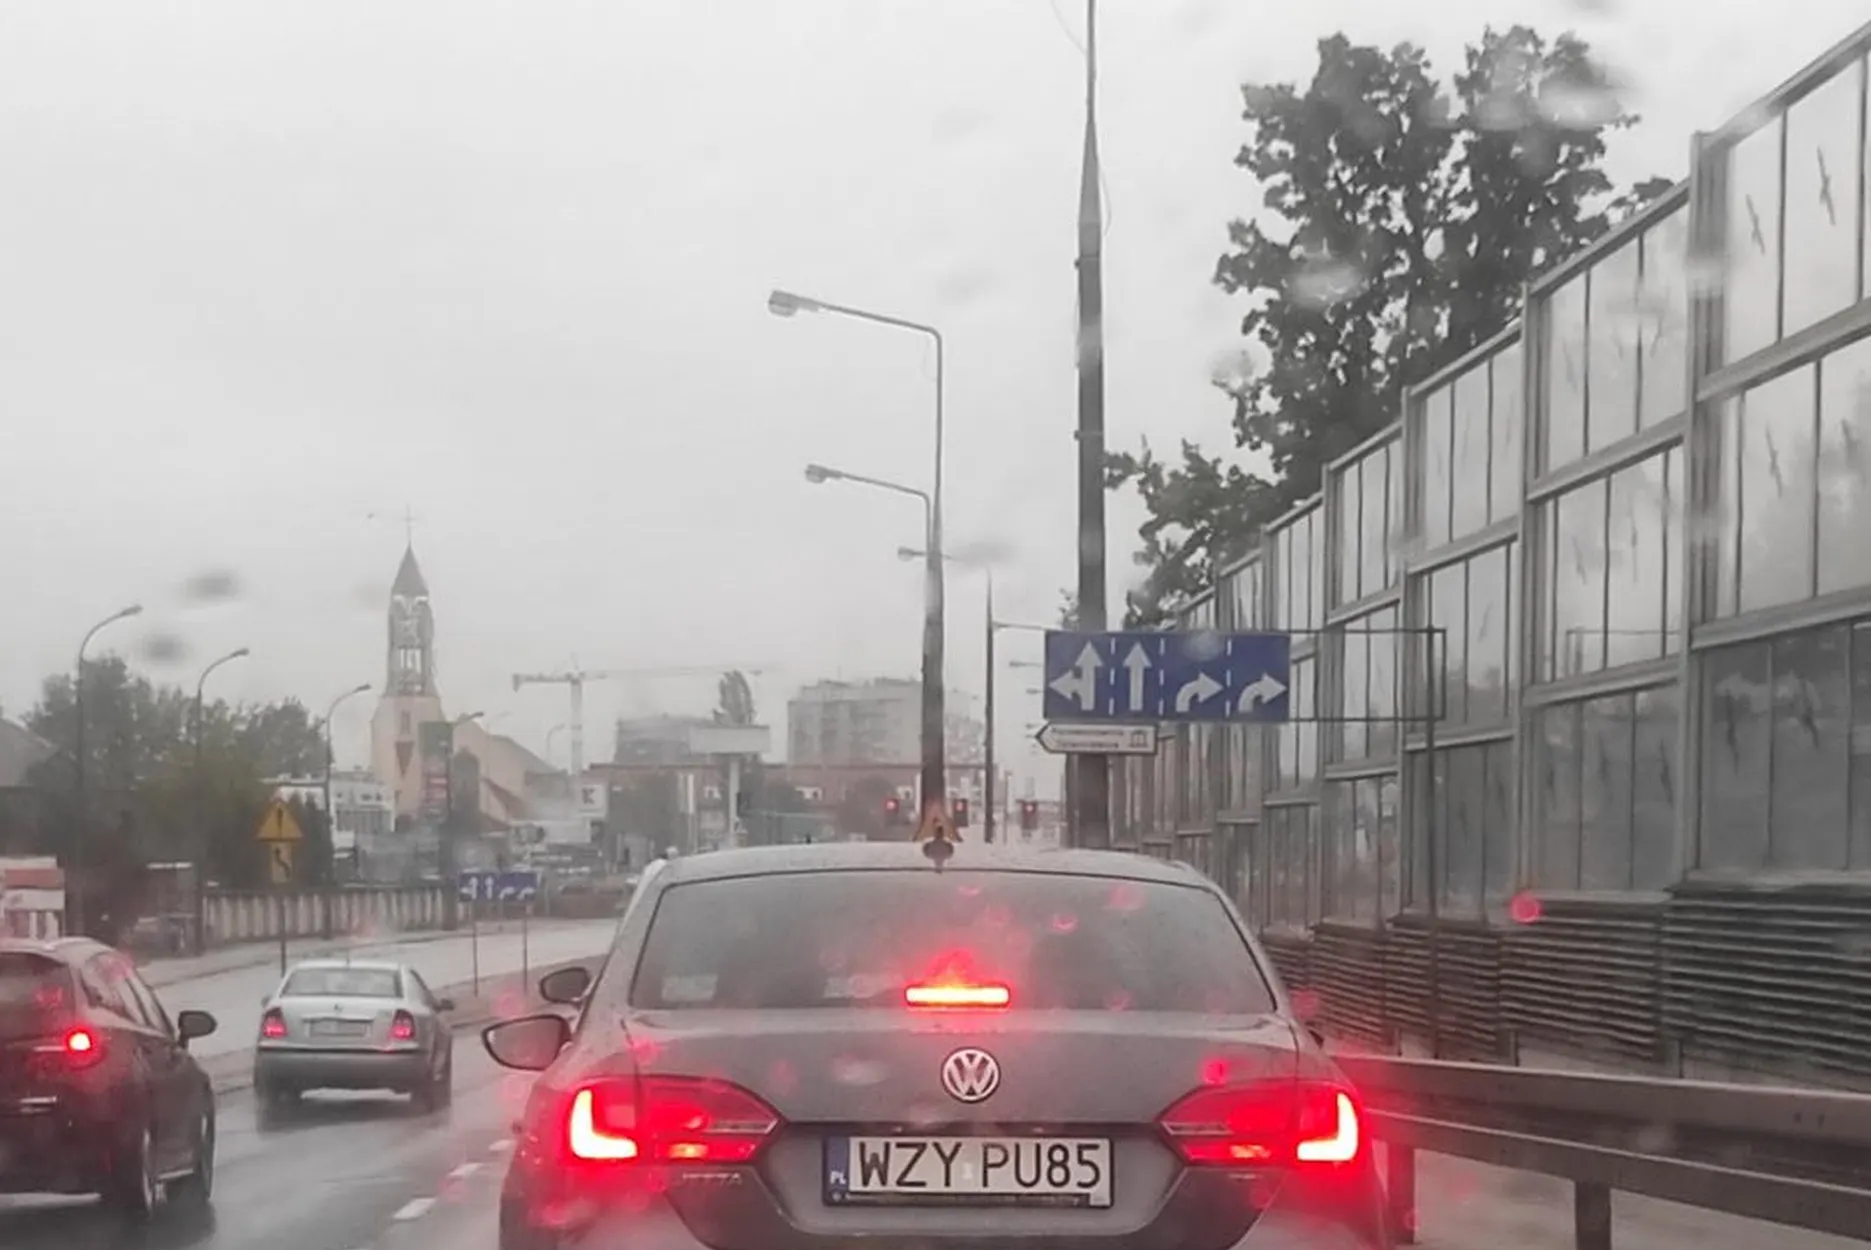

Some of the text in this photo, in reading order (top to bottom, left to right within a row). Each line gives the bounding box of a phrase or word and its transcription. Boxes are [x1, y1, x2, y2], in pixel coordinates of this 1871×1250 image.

[830, 1170, 847, 1185] PL
[859, 1141, 1101, 1189] WZY PU85
